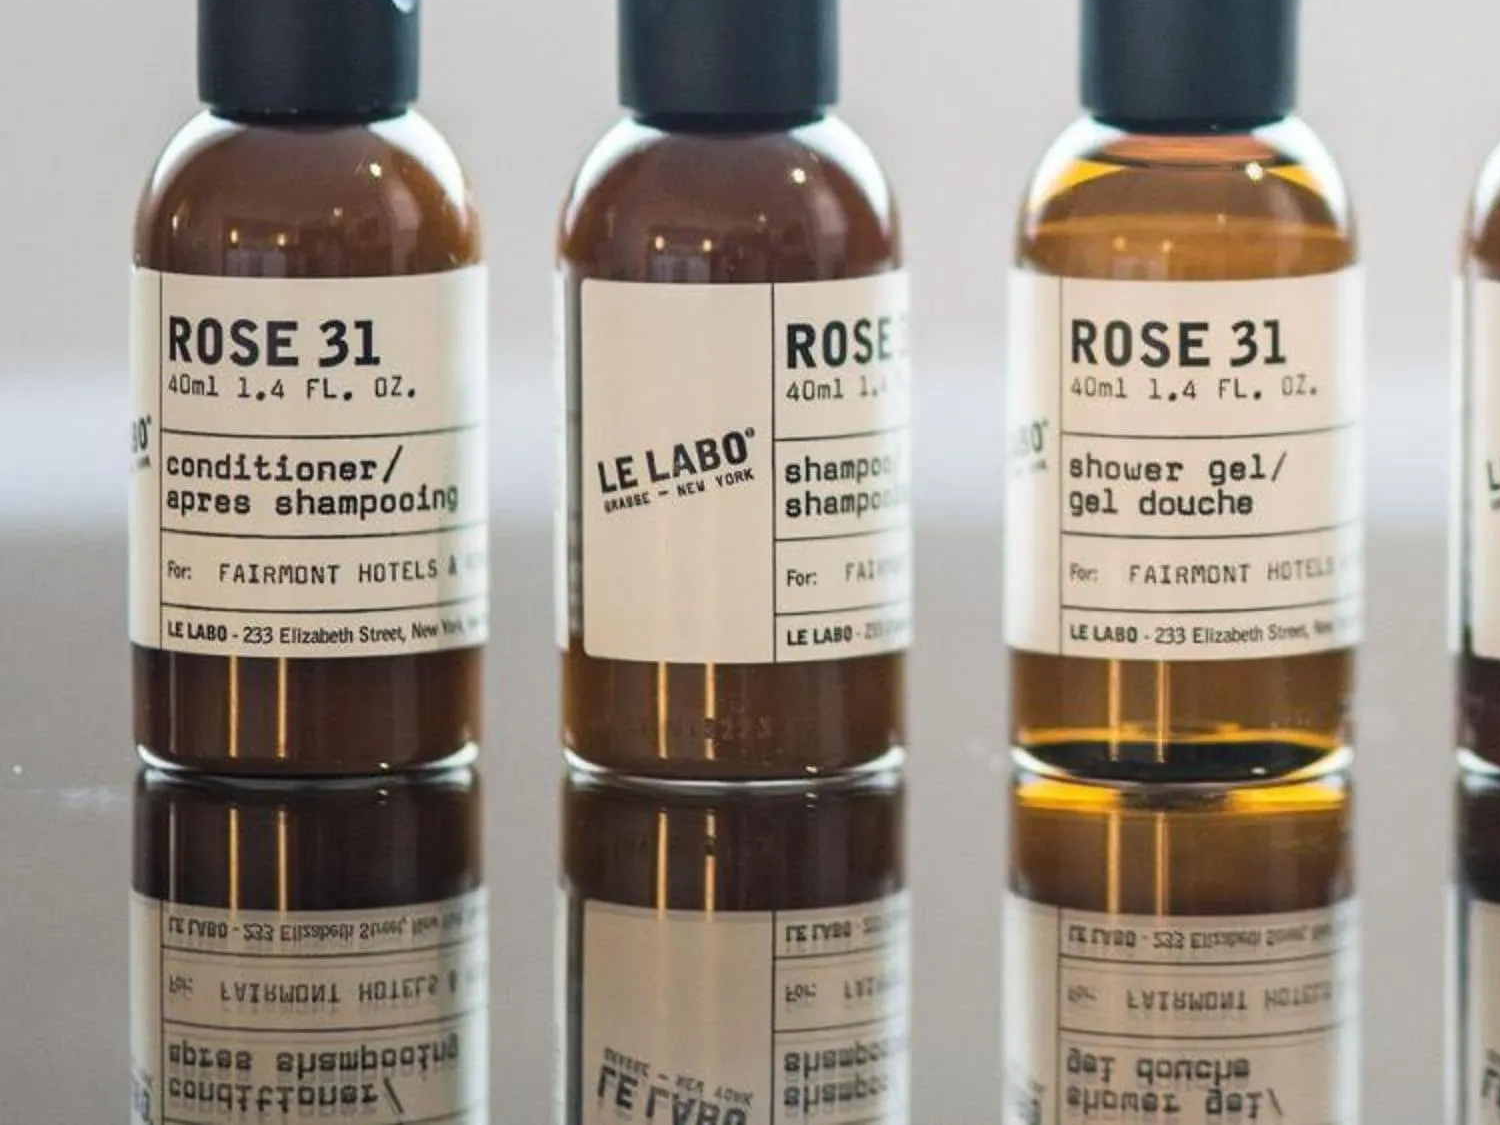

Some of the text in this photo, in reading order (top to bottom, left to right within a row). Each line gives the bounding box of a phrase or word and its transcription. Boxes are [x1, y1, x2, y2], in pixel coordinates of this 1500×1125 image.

[169, 315, 380, 367] ROSE 31
[787, 317, 892, 369] ROSE
[1071, 319, 1287, 368] ROSE 31
[168, 375, 417, 401] 40ml 1.4 FL. OZ.
[786, 377, 844, 401] 40ml
[1070, 376, 1127, 399] 40ml
[1149, 378, 1197, 402] 1.4
[1218, 378, 1262, 401] FL.
[167, 443, 403, 483] conditioner/
[597, 455, 638, 493] LE
[1069, 450, 1288, 486] shower gel/
[677, 480, 706, 497] NEW
[716, 468, 755, 487] YORK
[167, 483, 459, 519] apres shampooing
[1069, 487, 1254, 518] gel douche
[168, 559, 191, 581] For:
[218, 562, 340, 586] FAIRMONT
[358, 558, 438, 584] HOTELS
[786, 568, 817, 587] For:
[1128, 563, 1251, 585] FAIRMONT
[1266, 556, 1335, 581] HOTELS
[168, 620, 184, 639] LE
[186, 622, 227, 642] LABO
[243, 625, 273, 644] 233
[279, 624, 354, 644] Elizabeth
[411, 621, 438, 639] New
[787, 629, 808, 646] LE
[813, 625, 853, 644] LABO
[1070, 624, 1088, 640] LE
[1093, 625, 1138, 642] LABO
[1154, 627, 1186, 645] 233
[1193, 624, 1263, 645] Elizabeth
